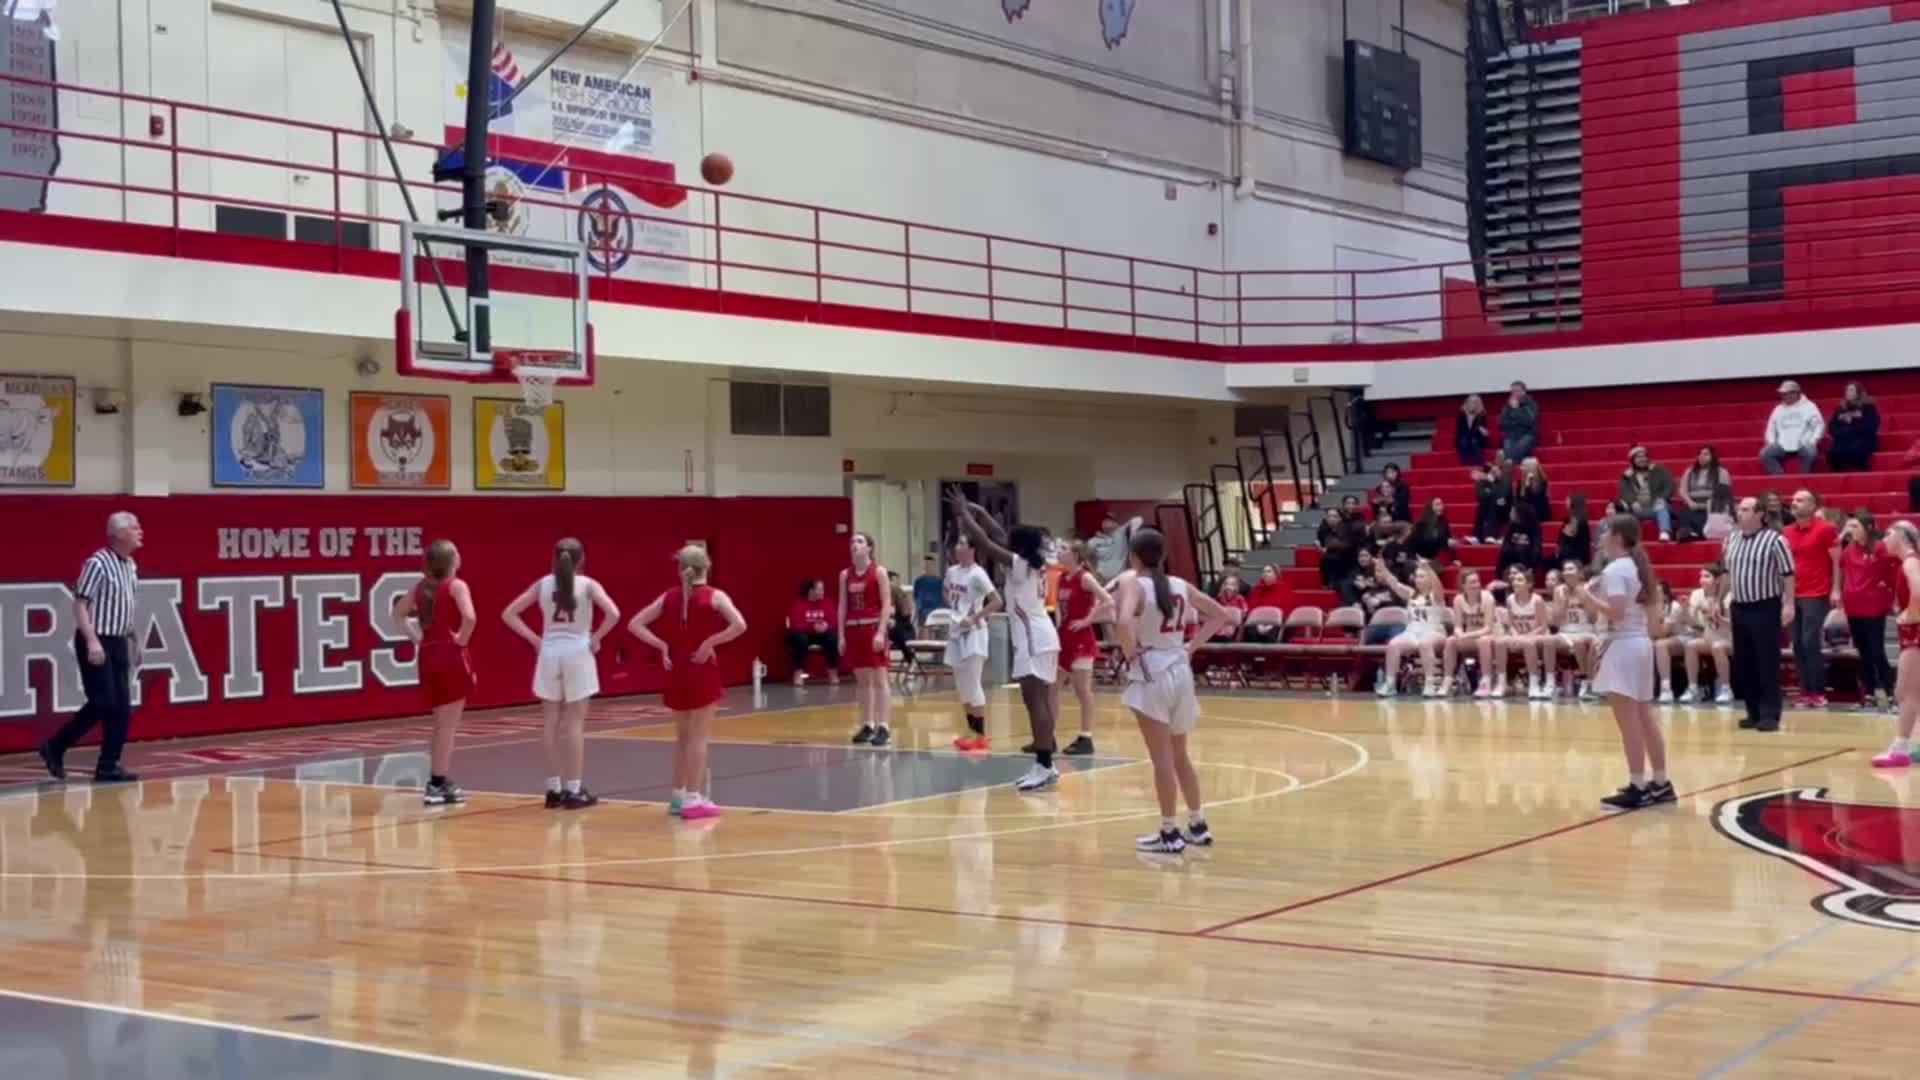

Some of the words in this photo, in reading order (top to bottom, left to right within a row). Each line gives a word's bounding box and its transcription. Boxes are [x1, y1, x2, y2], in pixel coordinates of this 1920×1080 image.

[550, 68, 580, 85] NEW
[217, 527, 310, 559] HOME
[319, 527, 356, 557] OF
[364, 527, 424, 556] THE
